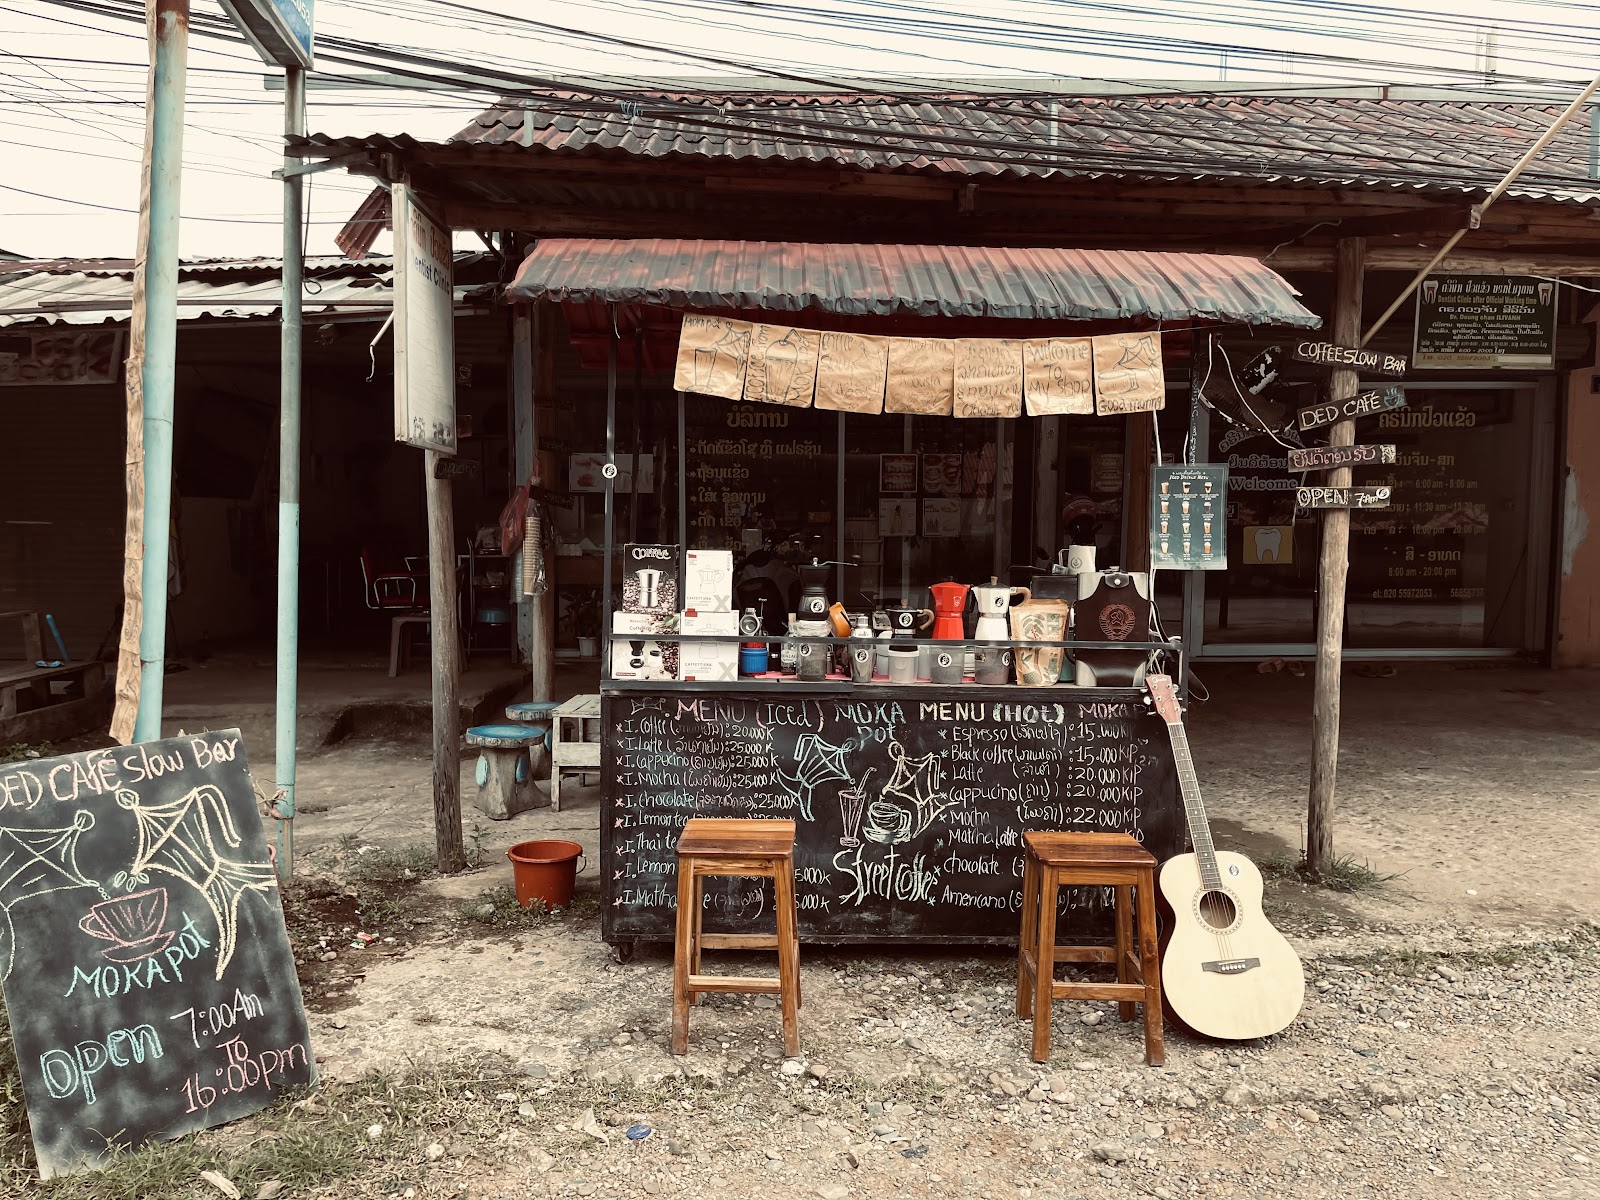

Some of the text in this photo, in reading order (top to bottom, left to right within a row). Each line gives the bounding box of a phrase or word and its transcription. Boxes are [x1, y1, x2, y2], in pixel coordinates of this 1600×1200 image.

[433, 268, 450, 295] Clinic
[1438, 295, 1456, 303] Dentist
[1457, 295, 1472, 304] Clinic
[1486, 296, 1504, 305] Official
[1505, 297, 1525, 306] Working
[1297, 342, 1343, 363] COFFEE
[1343, 349, 1378, 366] SLOW
[1301, 391, 1382, 427] DED CAFÉ
[1228, 476, 1299, 491] Welcome
[1416, 479, 1478, 489] 6:00 am 8:00 am
[1296, 489, 1349, 508] OPEN
[1435, 504, 1446, 512] am
[1388, 566, 1457, 578] 8:00 am 20:00 pm
[1383, 588, 1397, 599] 020
[1398, 588, 1433, 599] 55972053
[674, 699, 746, 722] MENU
[835, 700, 906, 724] MOKA
[919, 702, 985, 721] MENU
[952, 724, 1008, 748] Espresso
[190, 735, 240, 768] Bar
[951, 744, 978, 762] Black
[952, 763, 984, 782] Latte
[949, 807, 990, 827] Mocha
[941, 884, 1006, 910] Americano
